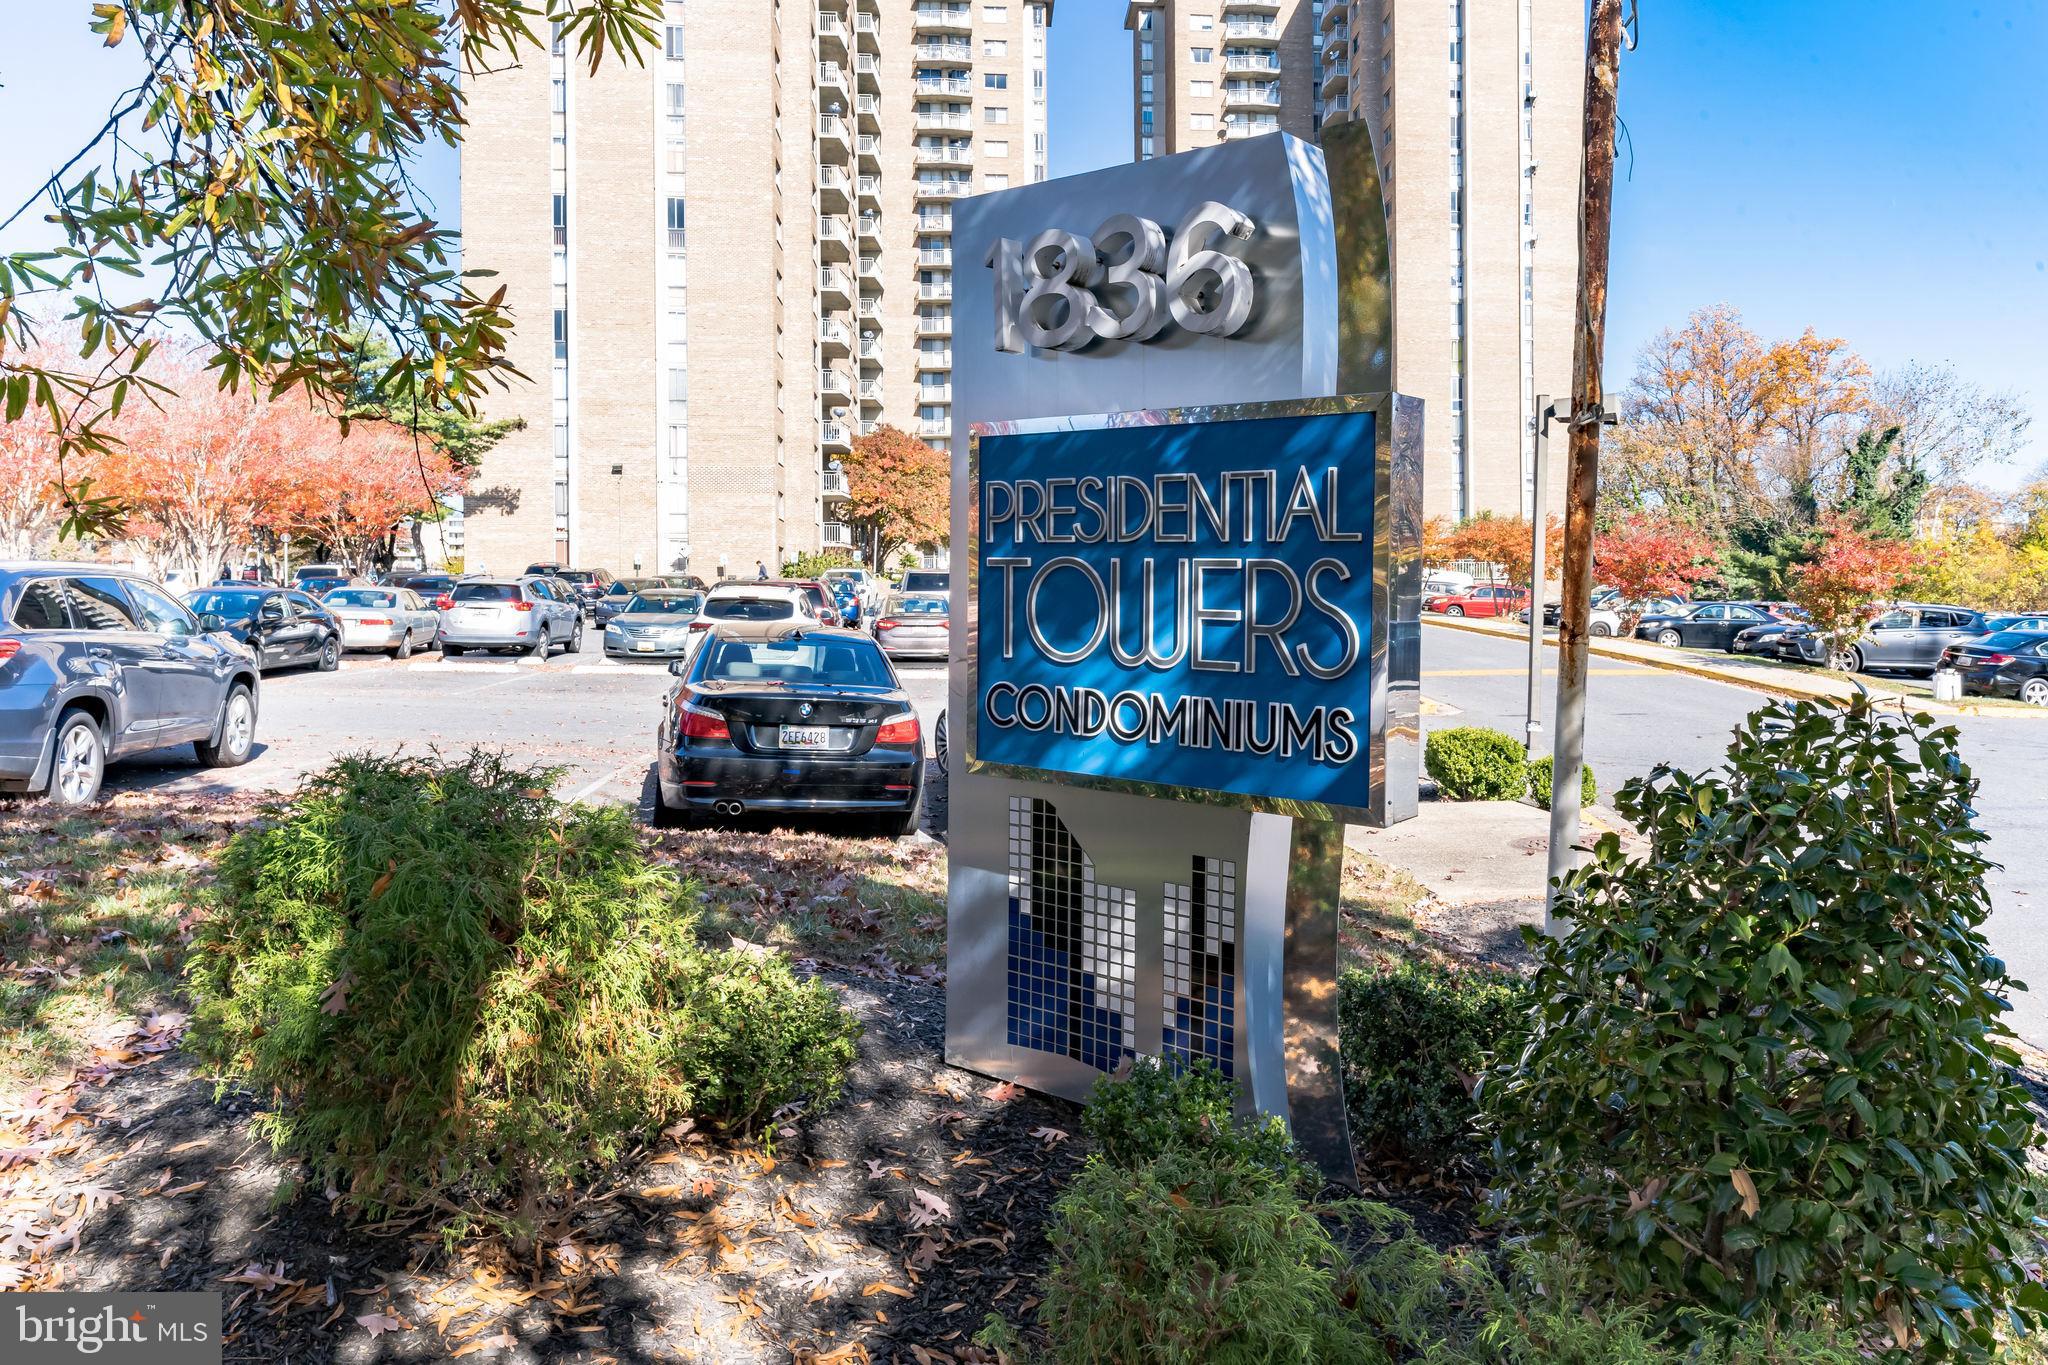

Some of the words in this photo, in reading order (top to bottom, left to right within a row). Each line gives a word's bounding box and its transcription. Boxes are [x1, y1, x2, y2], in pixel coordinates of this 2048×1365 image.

[984, 201, 1256, 354] 1836
[985, 465, 1362, 543] PRESIDENTIAL
[986, 556, 1360, 680] TOWERS
[782, 730, 826, 745] 2EE6428
[985, 681, 1358, 763] CONDOMINIUMS
